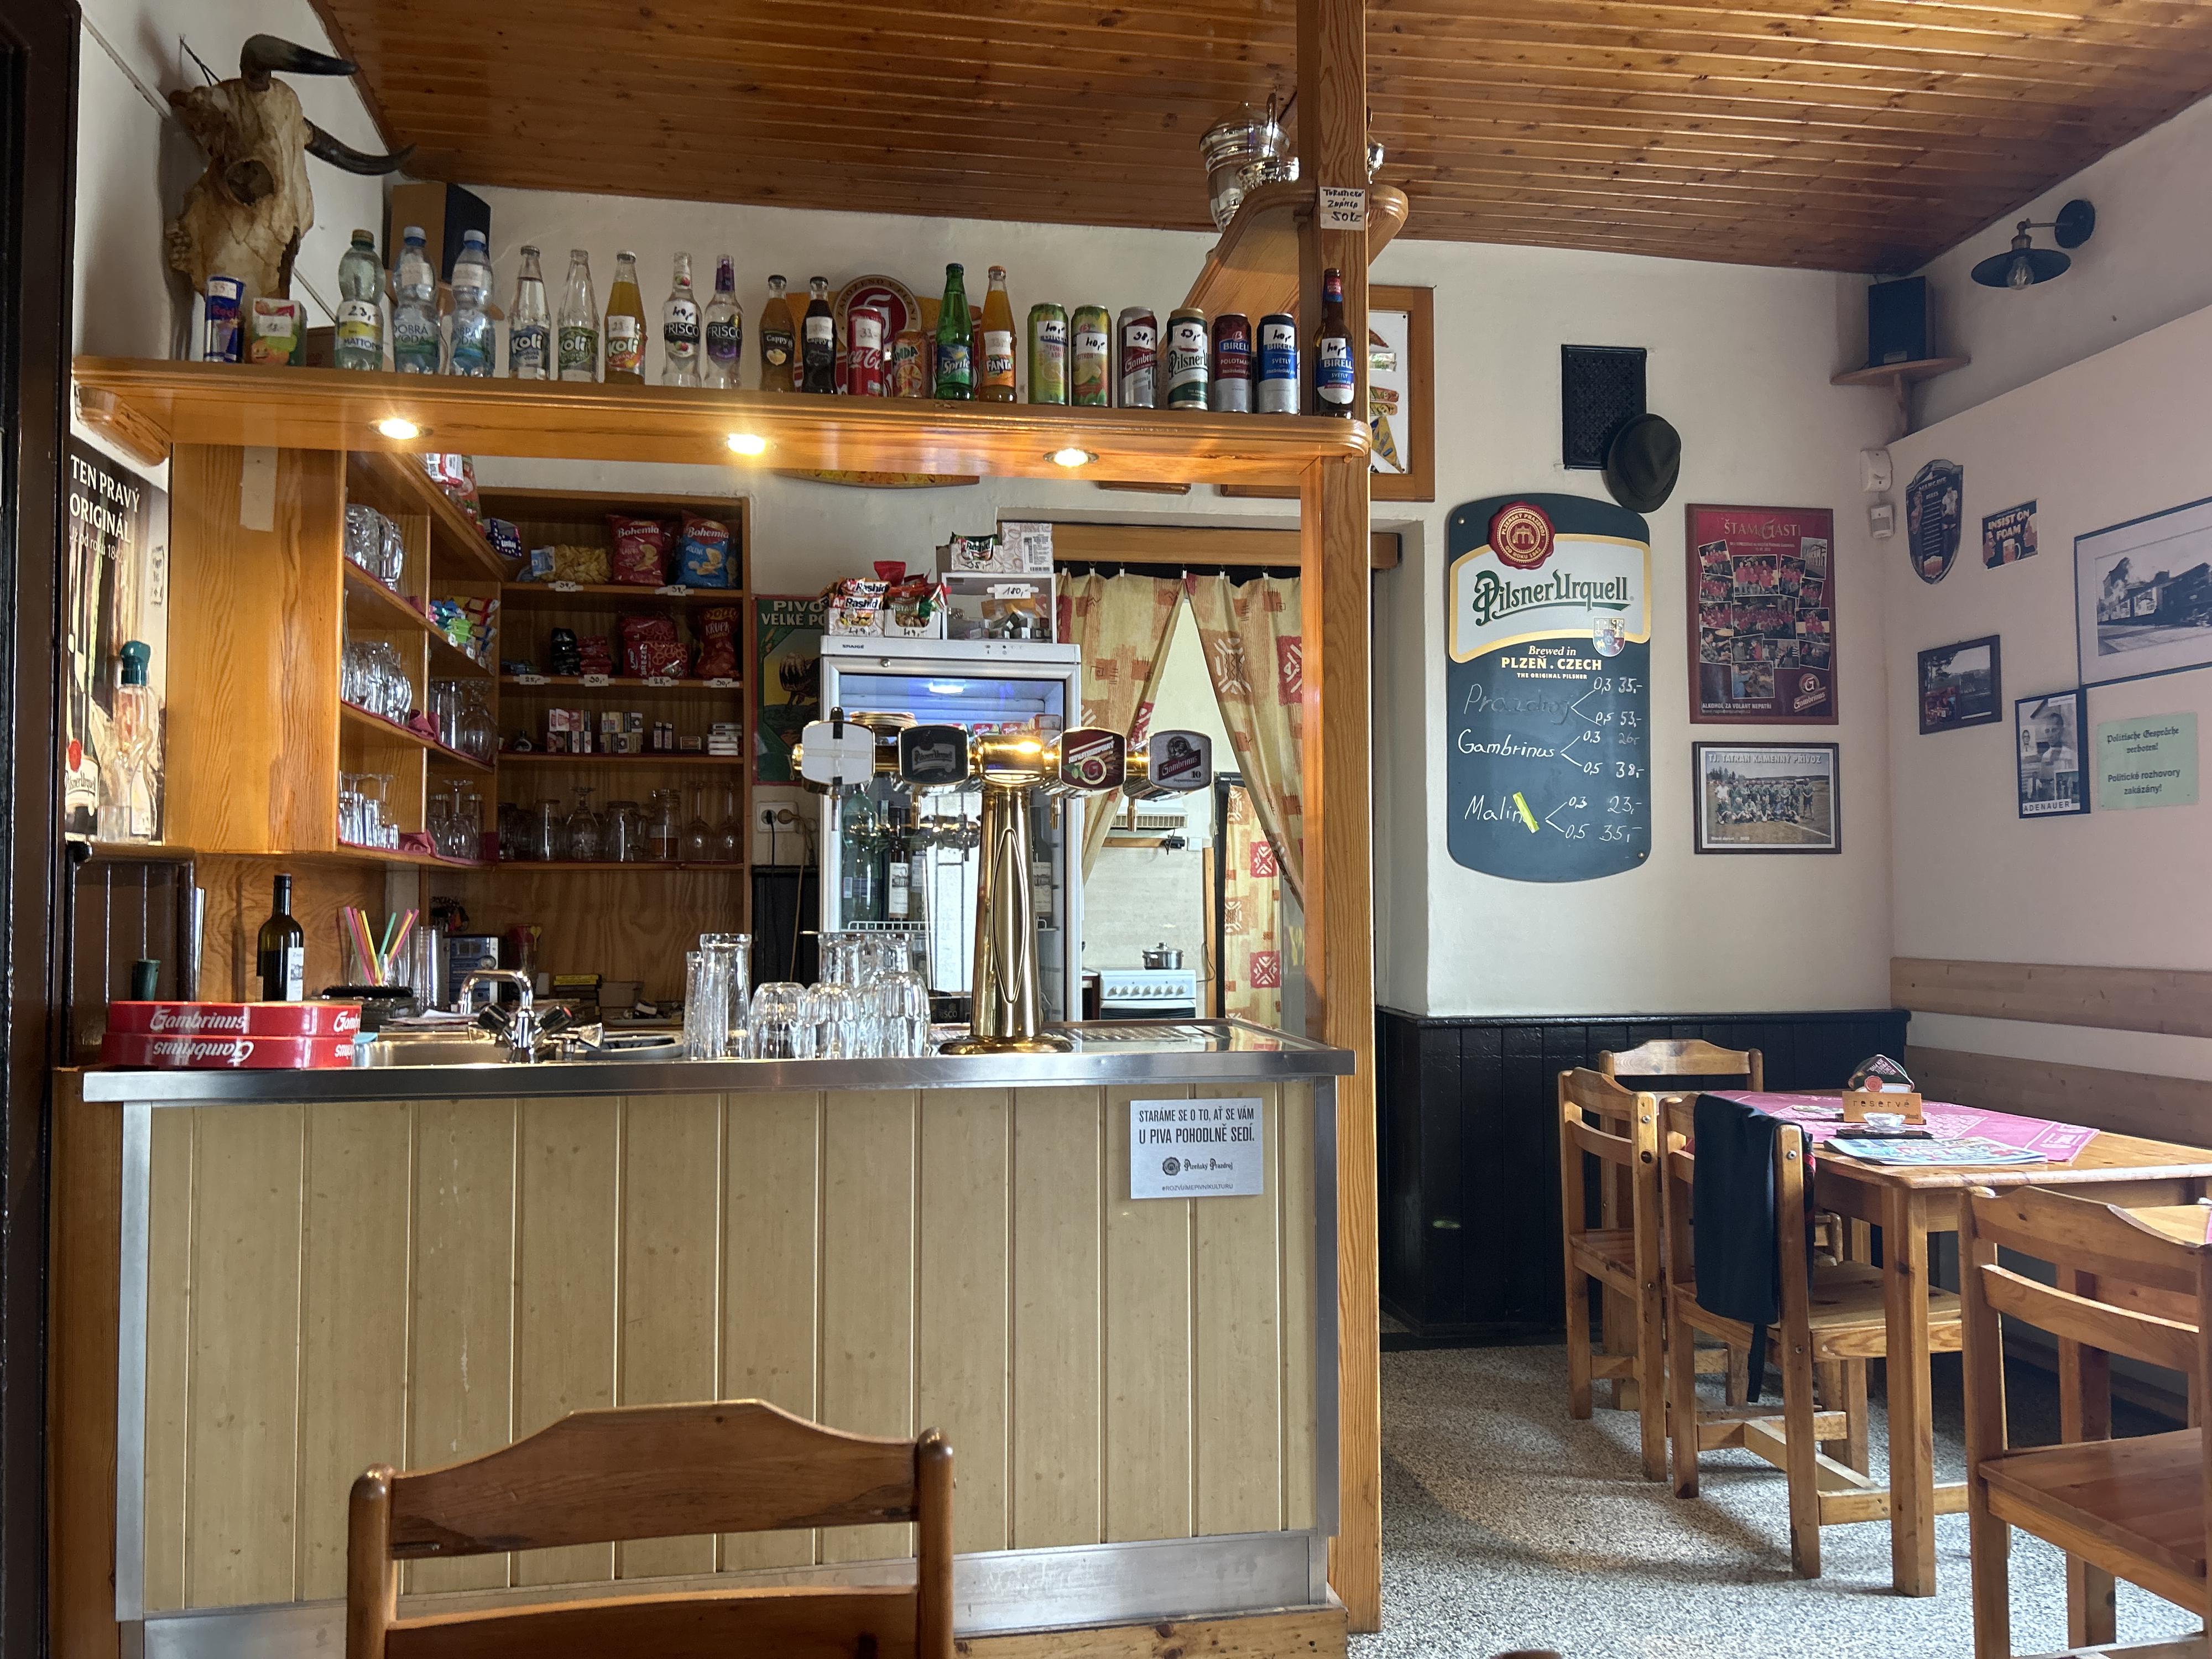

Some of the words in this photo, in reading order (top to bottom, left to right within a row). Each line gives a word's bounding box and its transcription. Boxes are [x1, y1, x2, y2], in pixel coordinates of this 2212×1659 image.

[664, 322, 700, 337] FRISCO
[707, 326, 742, 340] FRISCO
[942, 359, 970, 375] Sprite
[986, 358, 1012, 372] FANTA
[1324, 359, 1353, 369] BIRELL
[70, 454, 97, 491] TEN
[99, 471, 140, 513] PRAVÝ
[70, 492, 131, 544] ORIGINÁL
[1987, 512, 2016, 529] INSIST
[2016, 509, 2030, 521] ON
[618, 525, 659, 539] Bohemia
[687, 527, 730, 539] Bohemia
[1996, 524, 2021, 540] FOAM
[846, 597, 879, 609] Rashid
[1472, 570, 1554, 627] Pilsner
[1552, 568, 1629, 612] Urquell
[1528, 645, 1564, 656] Brewed
[1566, 645, 1577, 656] in
[1501, 653, 1547, 670] PLZEŇ
[1557, 659, 1602, 671] CZECH
[1793, 691, 1825, 709] Gambrinus
[1458, 729, 1555, 758] Gambrinus
[1162, 755, 1198, 776] Gambrinus
[1722, 754, 1751, 763] TATRAN
[1752, 754, 1791, 764] KAMENNÝ
[1192, 770, 1201, 779] 10
[2107, 772, 2140, 783] Politické
[2141, 769, 2181, 780] rozhovory
[1464, 795, 1529, 823] Malin
[2023, 800, 2070, 812] ADENAUER
[149, 1008, 246, 1032] Gambrinus
[153, 1041, 255, 1065] Gambrinus
[1139, 1107, 1176, 1123] STARÁME
[1178, 1109, 1188, 1121] SE
[1190, 1109, 1196, 1121] O
[1198, 1108, 1211, 1122] TO,
[1213, 1105, 1223, 1121] AŤ
[1225, 1108, 1235, 1120] SE
[1237, 1105, 1254, 1120] VÁM
[1139, 1129, 1146, 1144] U
[1150, 1128, 1172, 1144] PIVA
[1176, 1123, 1227, 1144] POHODLNĚ
[1231, 1123, 1255, 1142] SEDÍ.
[1209, 1157, 1233, 1171] Prazdroj
